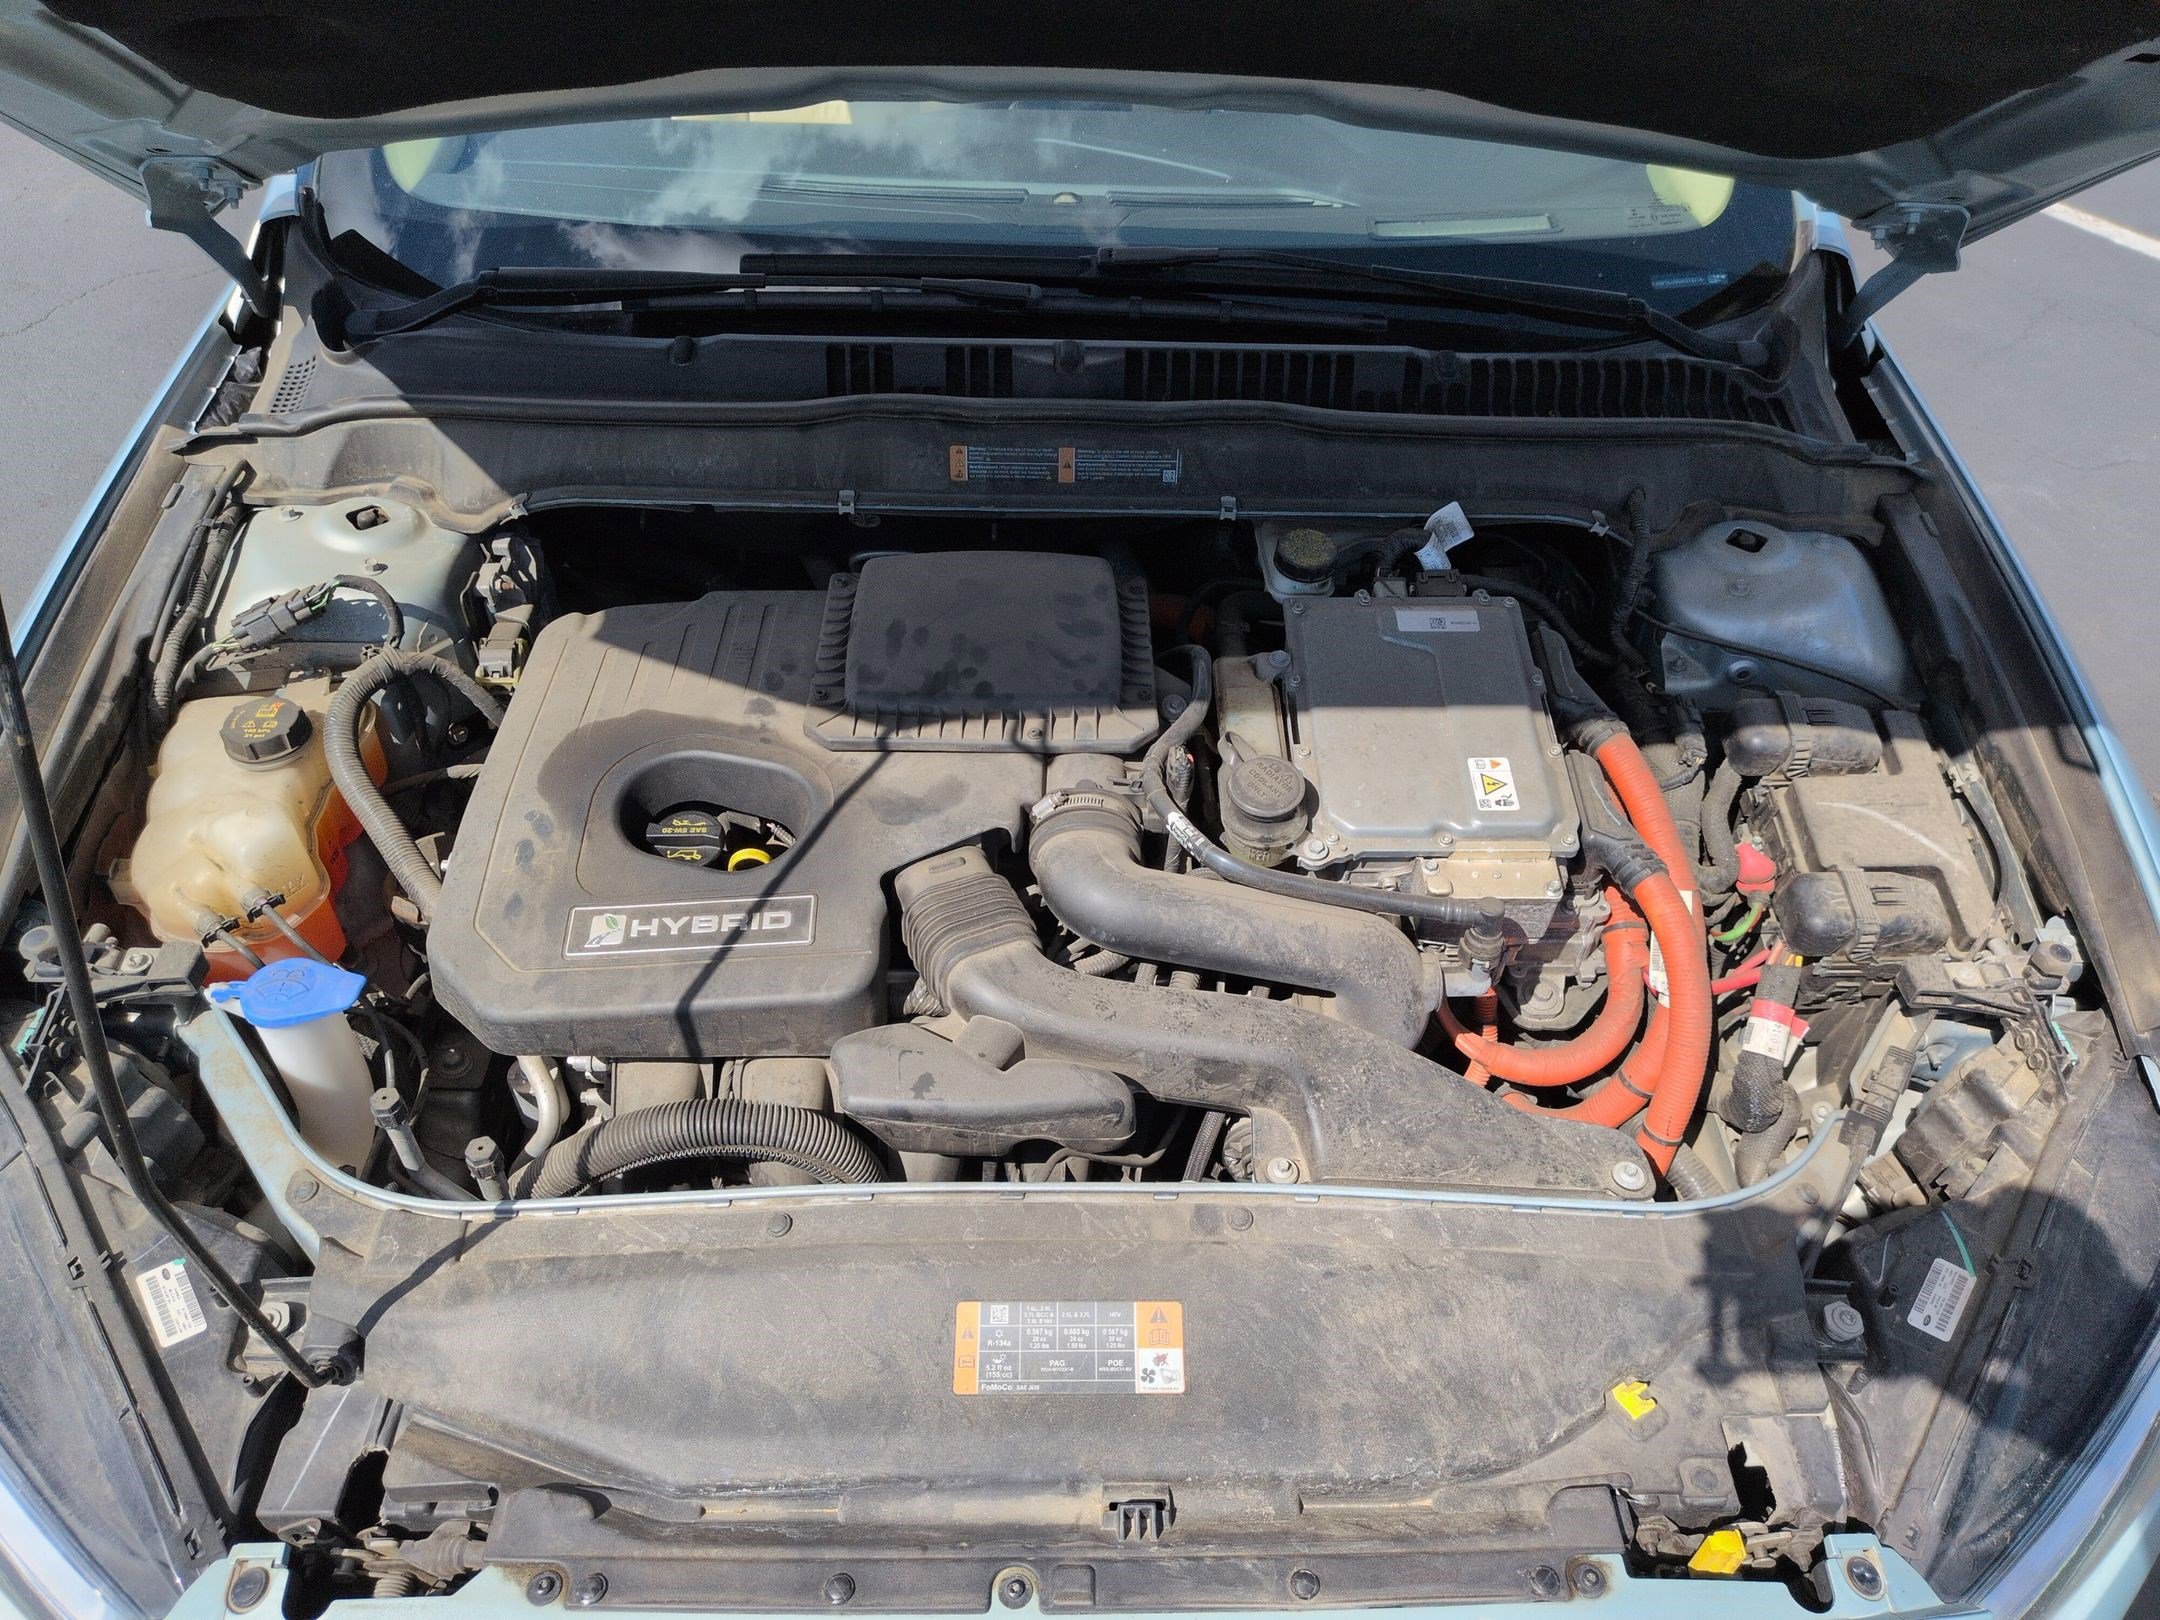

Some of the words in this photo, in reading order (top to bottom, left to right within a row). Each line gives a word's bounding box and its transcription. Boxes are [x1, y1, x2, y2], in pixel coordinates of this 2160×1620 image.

[1248, 769, 1282, 798] COOLANT
[1256, 762, 1294, 793] RADIATOR
[1247, 781, 1266, 798] ONLY
[629, 910, 792, 937] HYBRID
[1044, 1328, 1052, 1336] kg
[1081, 1328, 1089, 1336] kg
[1120, 1328, 1128, 1336] kg
[981, 1383, 1013, 1391] FoMoCo
